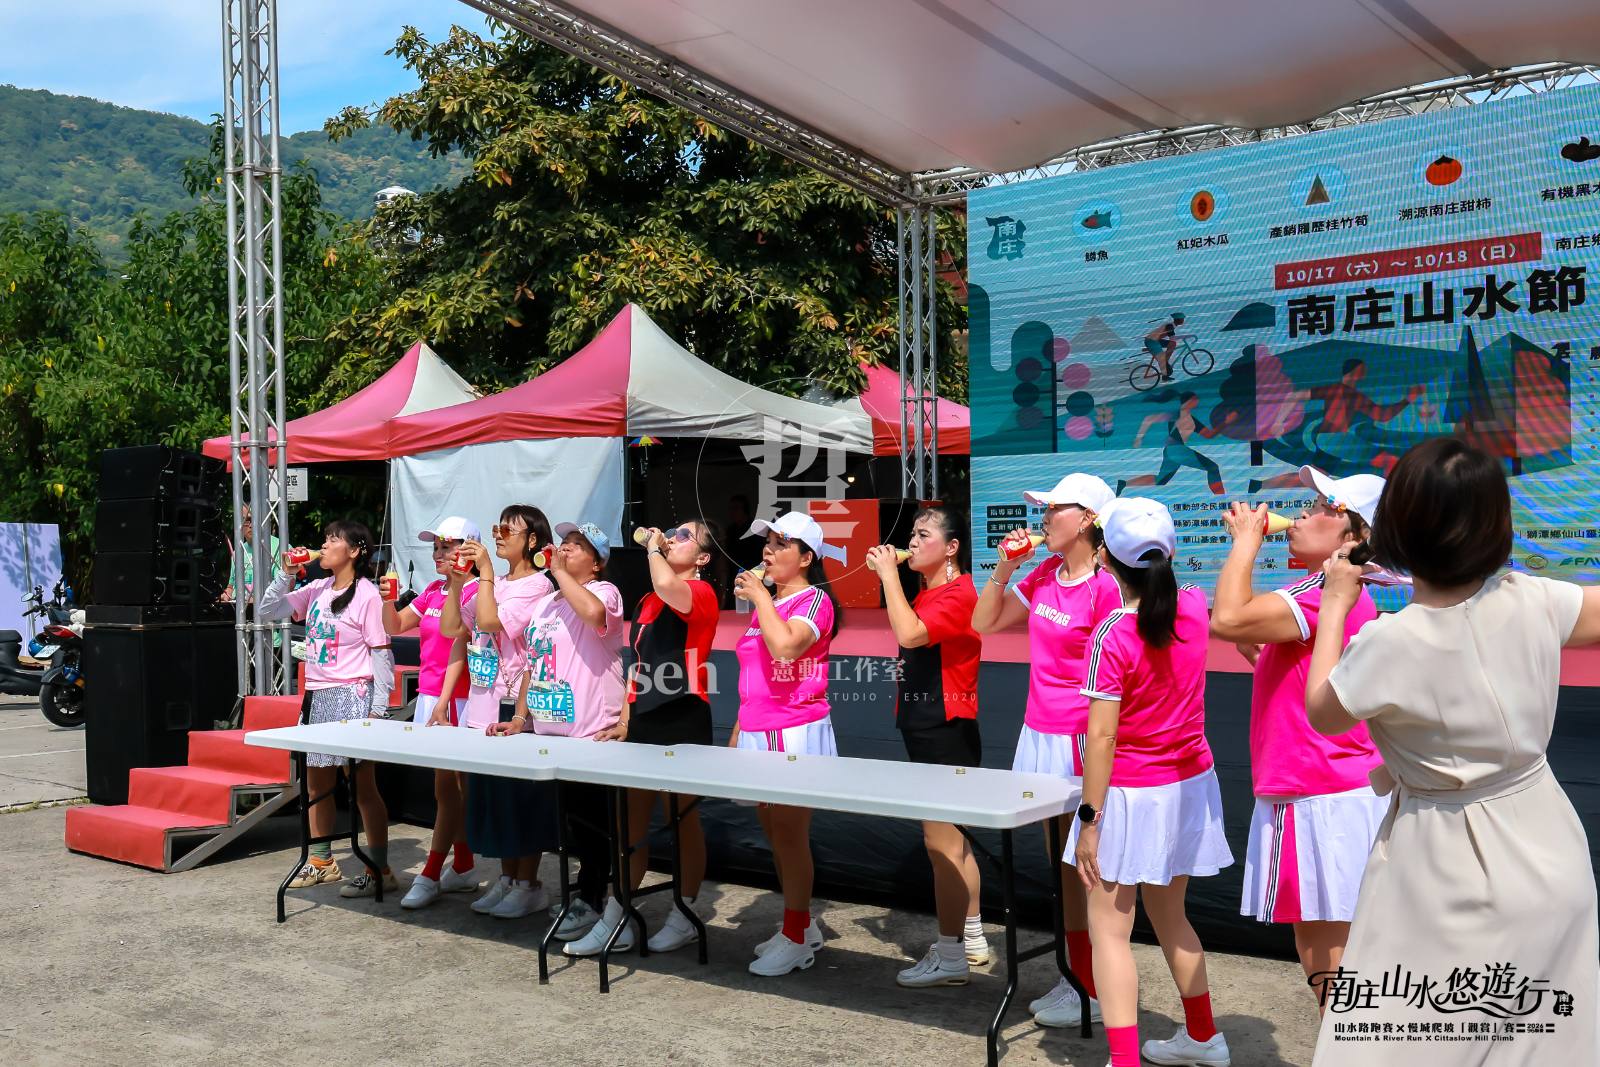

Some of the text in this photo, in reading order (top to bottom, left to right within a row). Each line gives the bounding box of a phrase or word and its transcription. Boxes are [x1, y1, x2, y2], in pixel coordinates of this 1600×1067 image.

[1398, 197, 1492, 222] 溯源南庄甜柿
[1269, 214, 1369, 240] 產銷履歷桂竹筍
[1176, 233, 1230, 251] 紅妃木瓜
[1287, 265, 1587, 338] 南庄山水節
[526, 693, 564, 709] 60517
